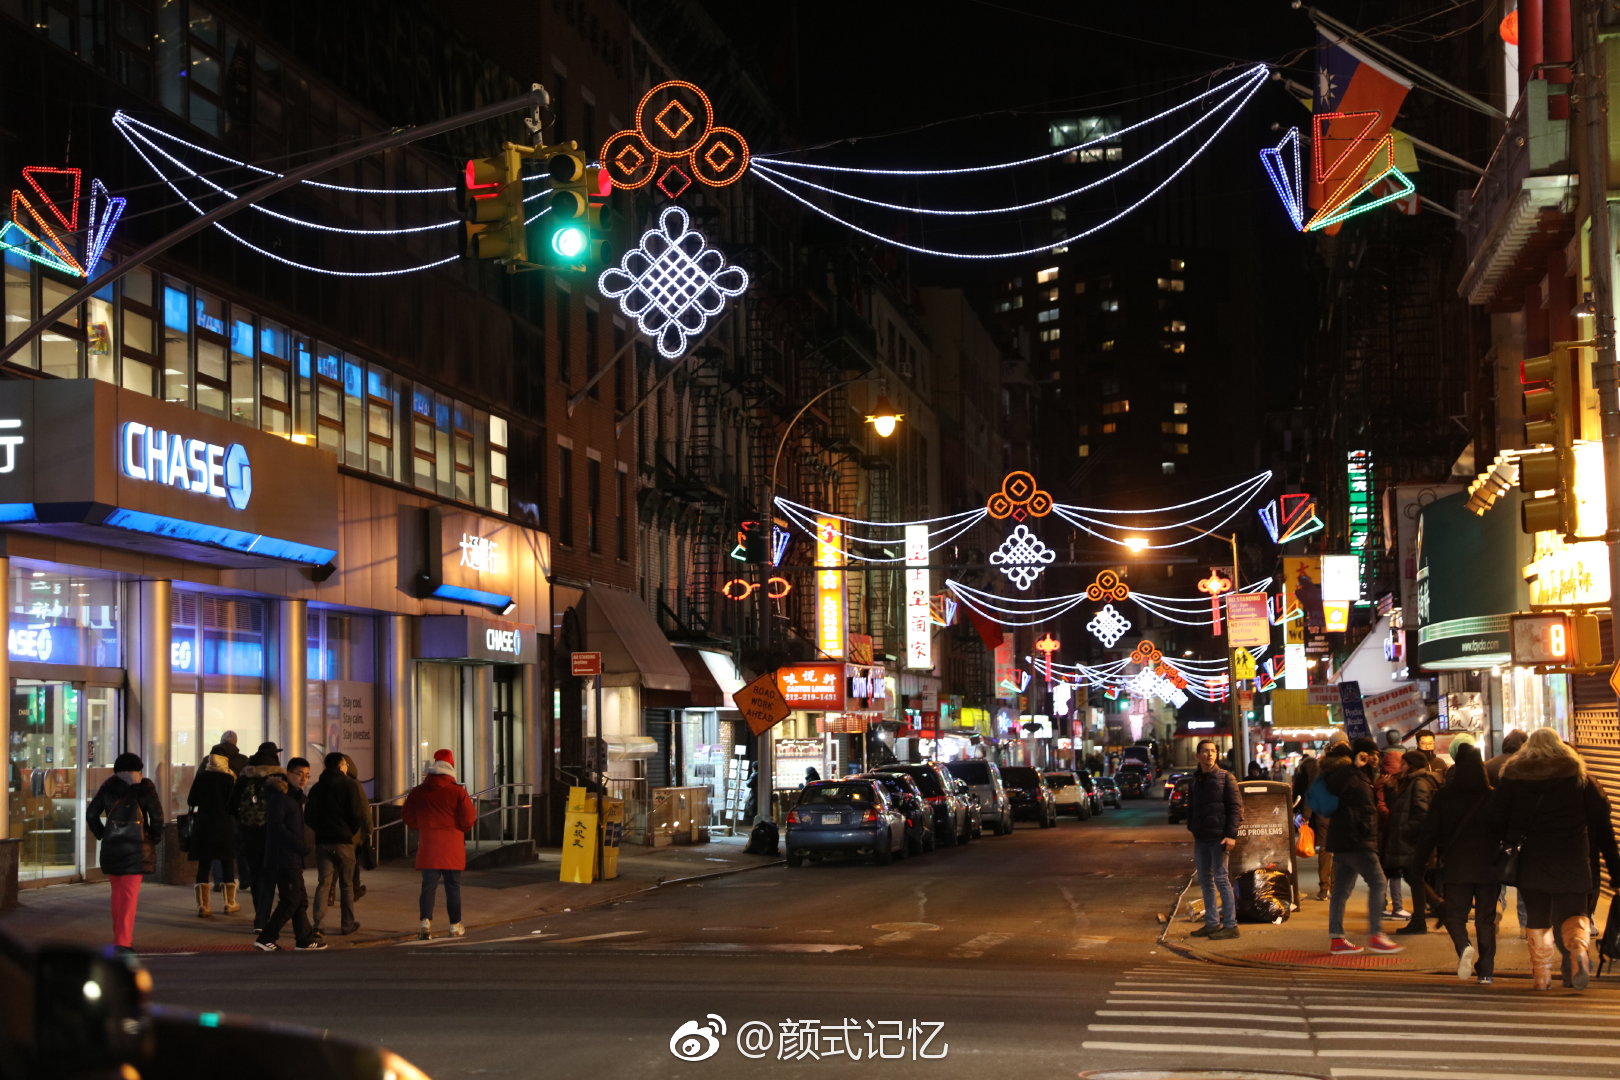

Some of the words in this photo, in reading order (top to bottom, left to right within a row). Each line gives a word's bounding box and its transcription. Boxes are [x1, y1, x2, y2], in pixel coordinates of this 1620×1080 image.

[122, 421, 226, 498] CHASE
[486, 628, 514, 652] CHASE
[753, 686, 775, 699] ROAD
[1365, 685, 1414, 708] PERFUME
[751, 699, 774, 711] WORK
[746, 710, 774, 722] AHEAD
[1247, 828, 1283, 836] PROBLEMS
